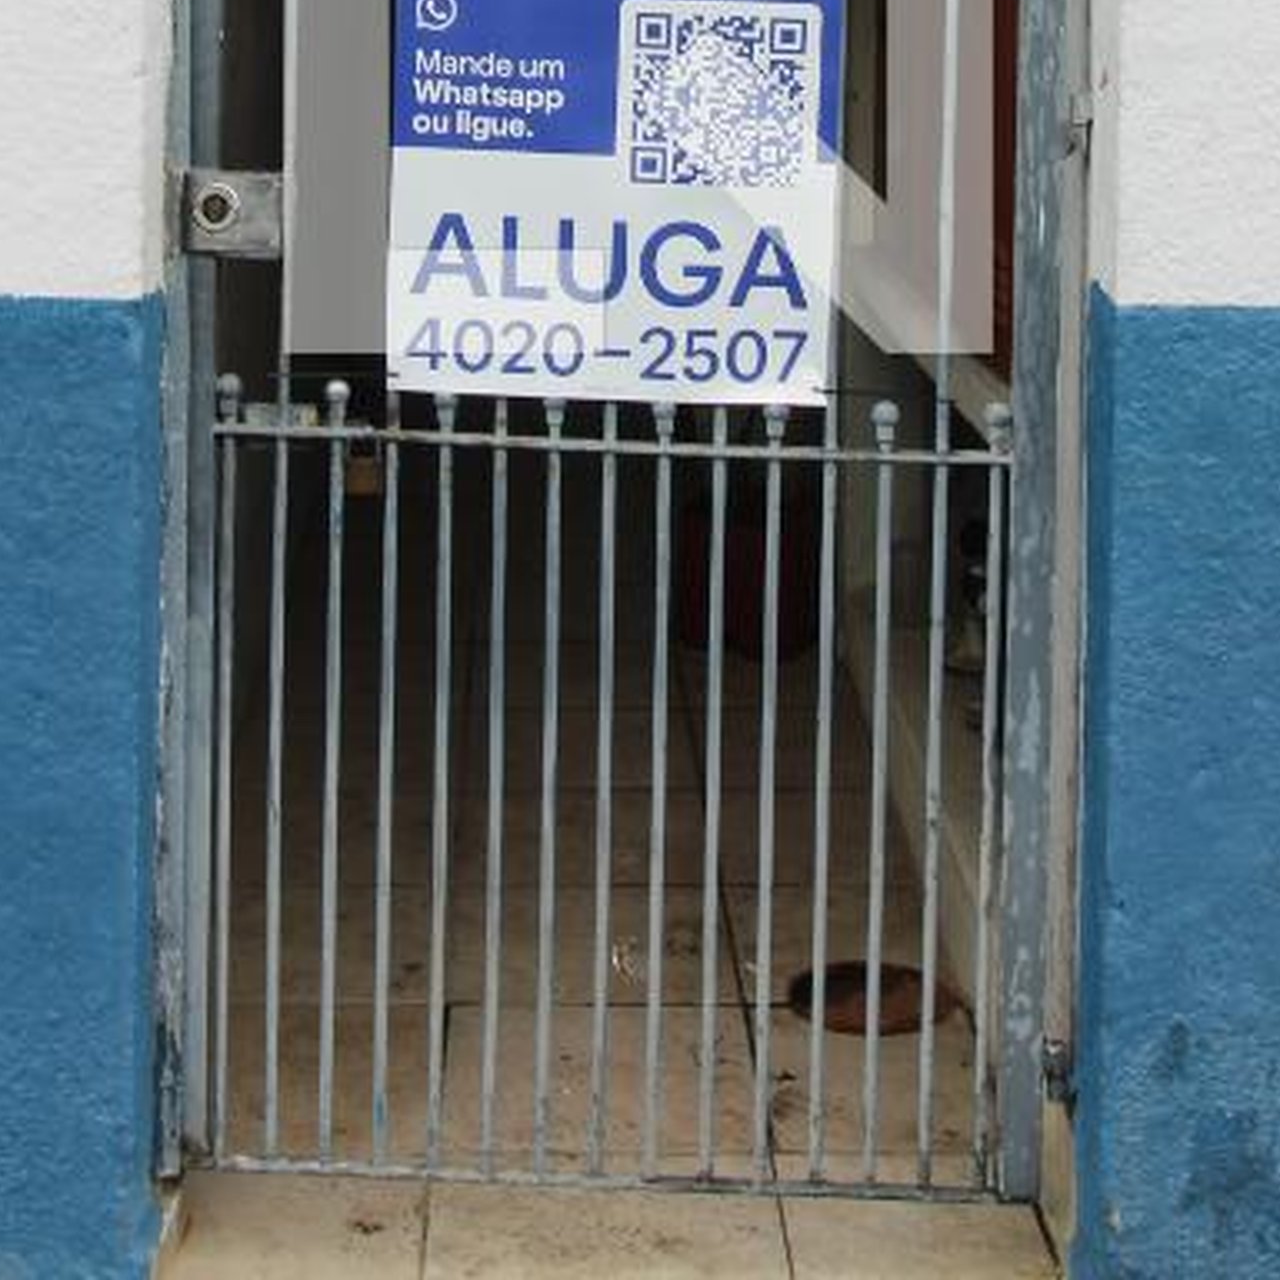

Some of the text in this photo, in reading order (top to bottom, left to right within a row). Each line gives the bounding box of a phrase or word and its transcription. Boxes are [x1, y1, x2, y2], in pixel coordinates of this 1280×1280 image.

[415, 50, 565, 81] Mande um
[412, 77, 566, 114] Whatsapp
[412, 109, 534, 142] ou ligue.
[410, 211, 808, 311] ALUGA
[405, 318, 809, 384] 4020-2507
